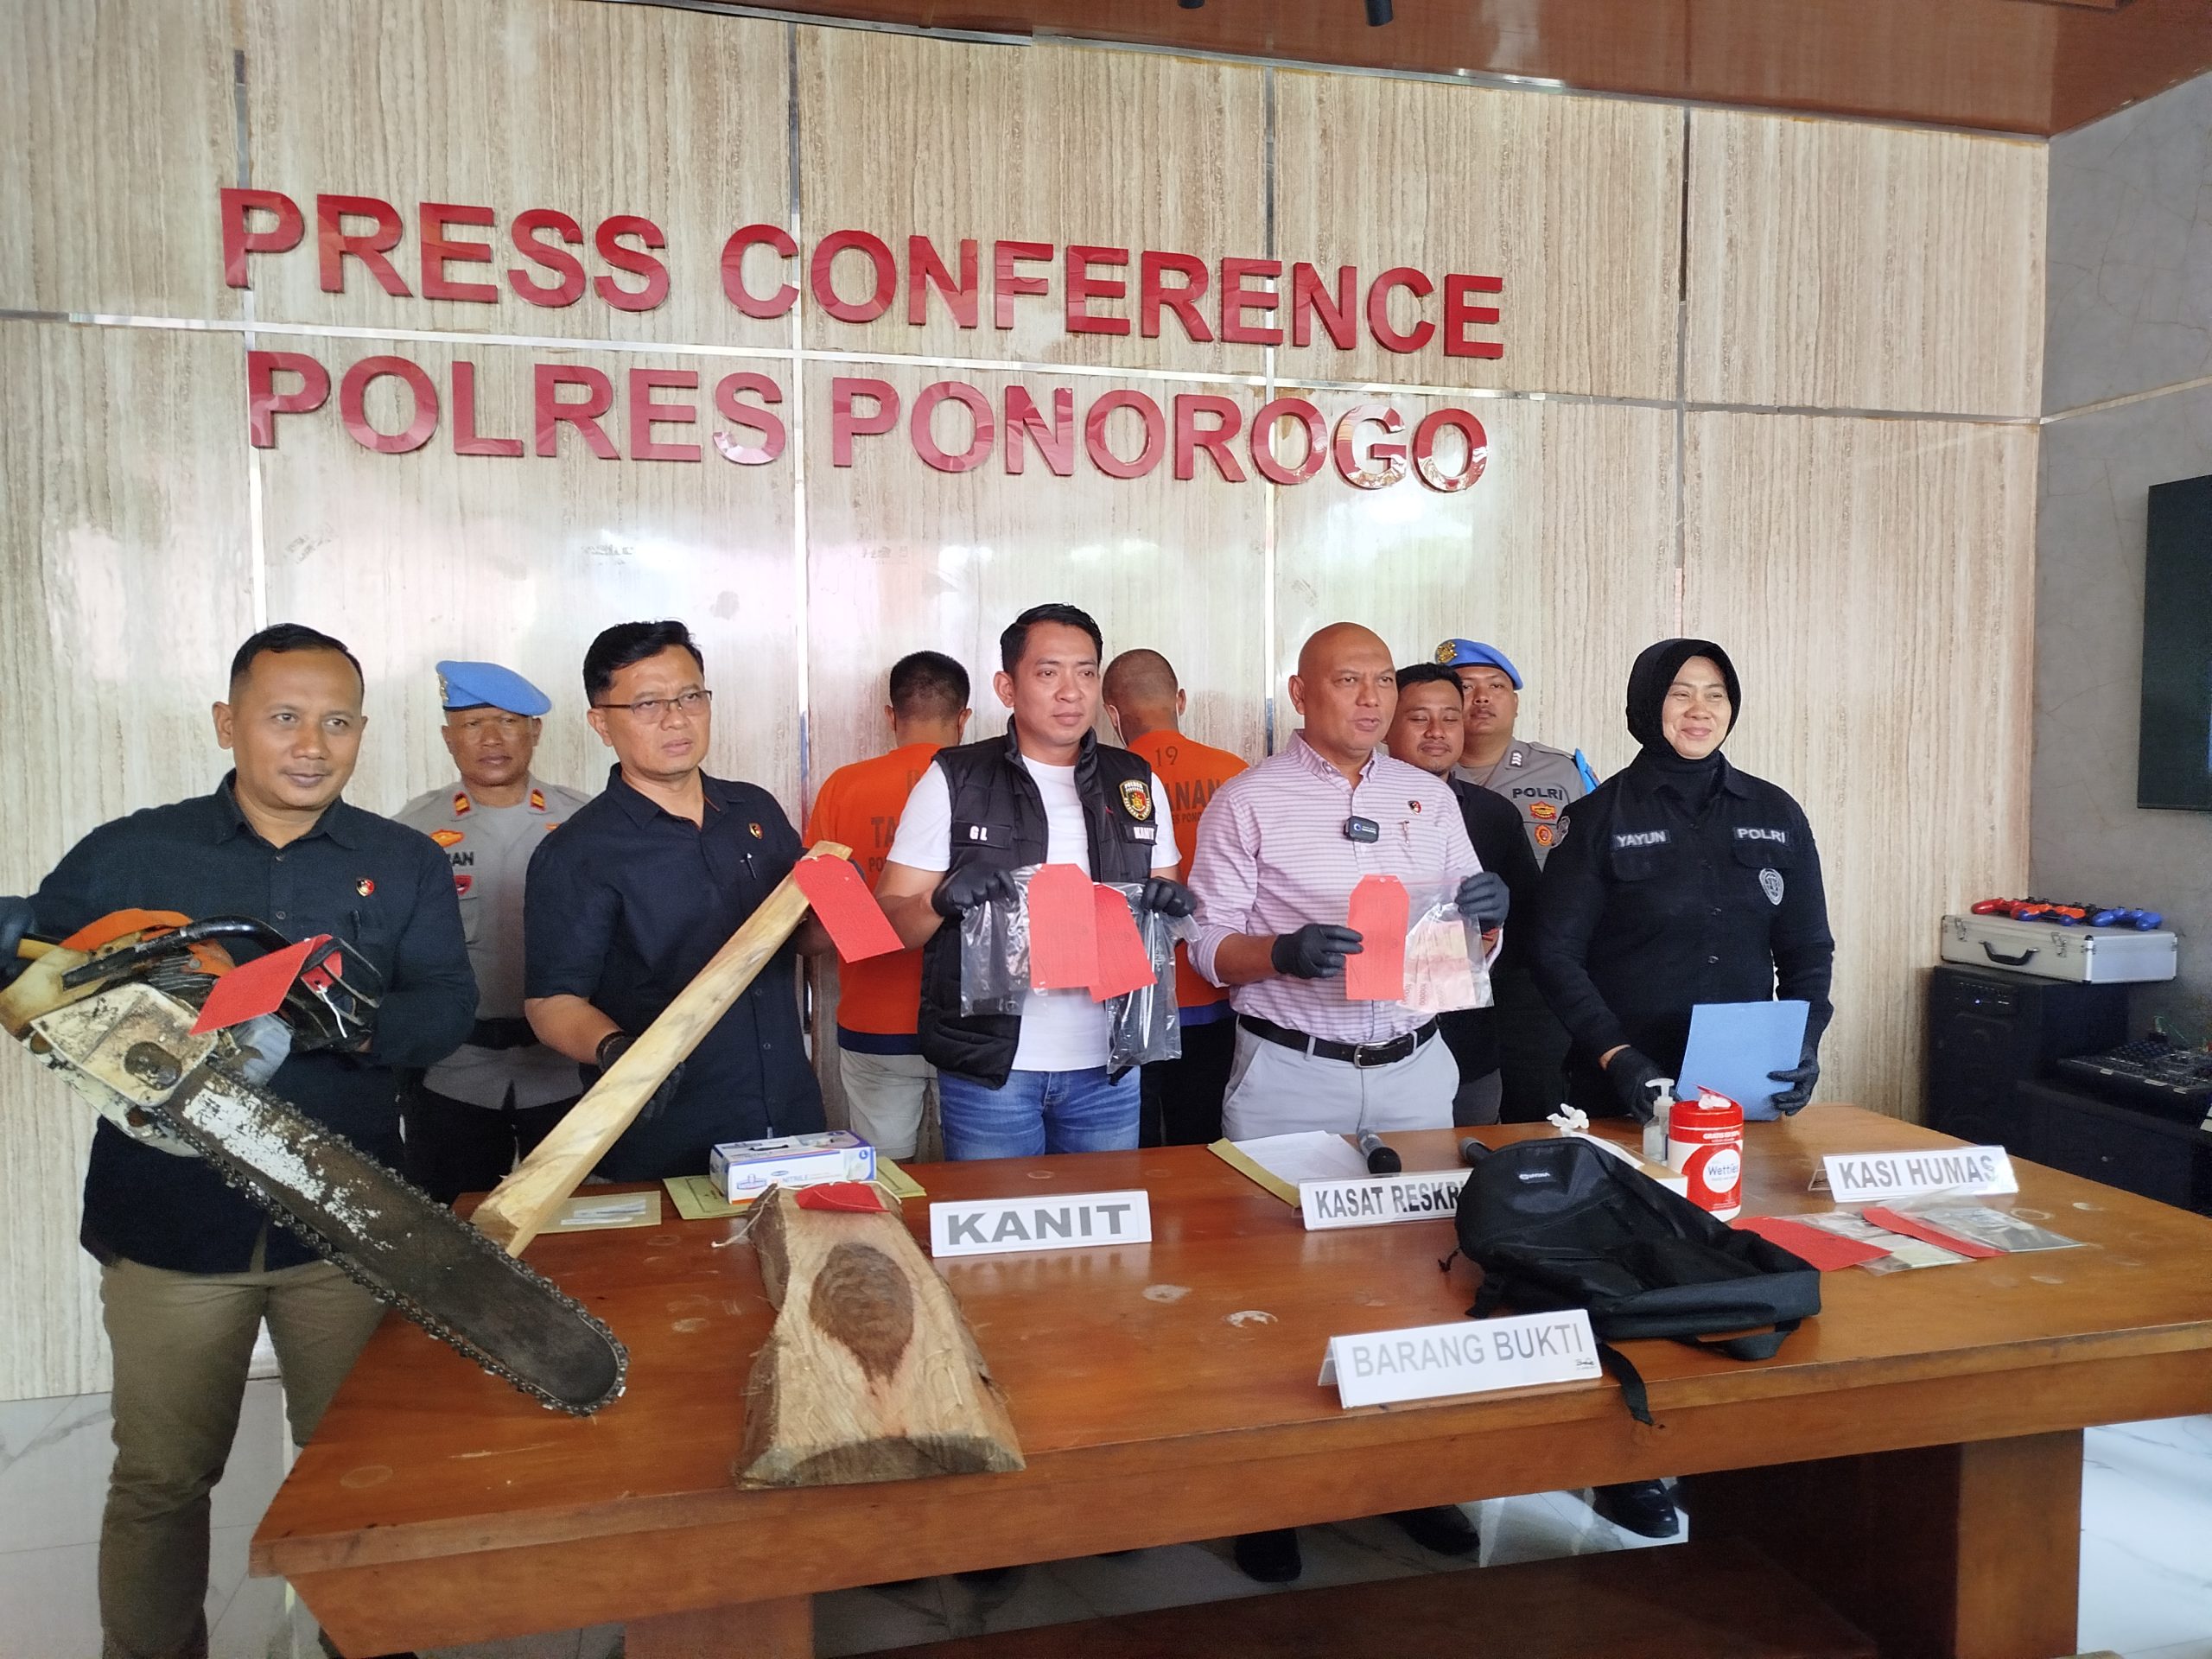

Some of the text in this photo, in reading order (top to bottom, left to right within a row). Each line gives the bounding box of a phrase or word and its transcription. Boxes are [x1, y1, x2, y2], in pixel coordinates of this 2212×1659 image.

[220, 188, 1503, 359] PRESS CONFERENCE
[247, 350, 1489, 493] POLRES PONOROGO
[1155, 746, 1178, 767] 19
[1512, 787, 1562, 800] POLRI
[969, 825, 988, 841] GL
[1616, 831, 1666, 847] YAYUN
[1737, 828, 1786, 843] POLRI
[448, 851, 474, 866] AN
[1839, 1155, 1997, 1190] KASI HUMAS
[1315, 1181, 1464, 1218] KASAT RESKR
[948, 1204, 1132, 1245] KANIT
[1352, 1323, 1584, 1377] BARANG BUKTI
